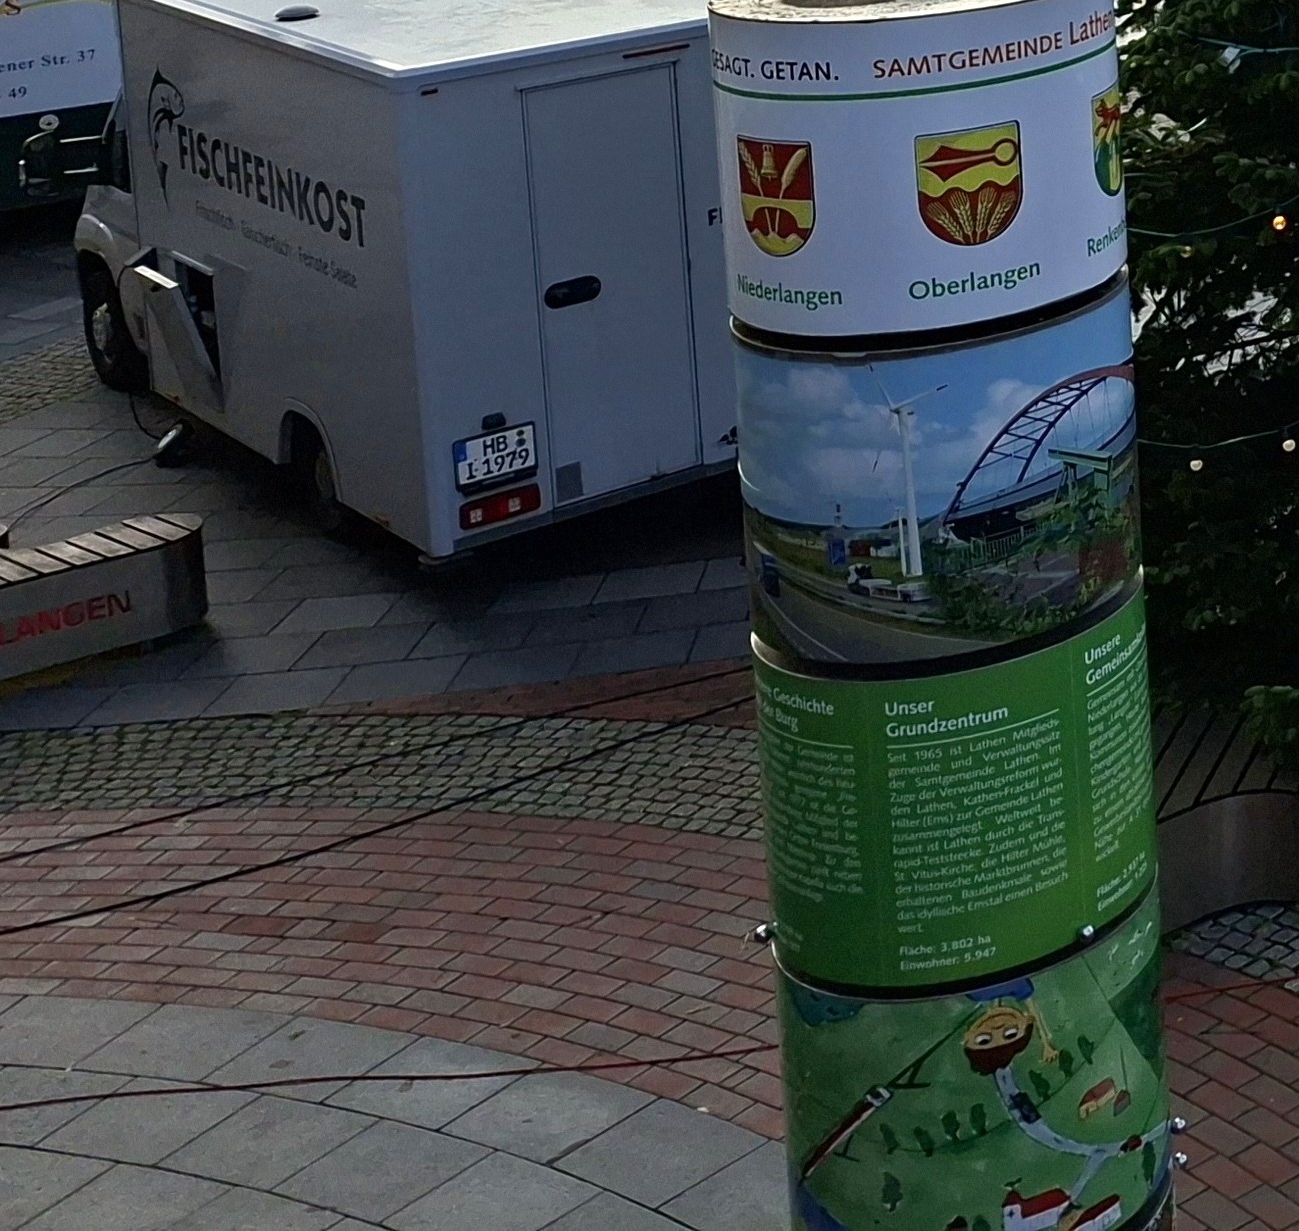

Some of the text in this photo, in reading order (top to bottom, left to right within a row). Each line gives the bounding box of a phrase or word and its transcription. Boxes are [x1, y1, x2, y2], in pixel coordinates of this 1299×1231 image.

[40, 54, 70, 67] Str.
[77, 49, 96, 63] 37
[760, 60, 840, 81] GETAN.
[872, 31, 1062, 79] SAMTGEMEINDE
[8, 85, 28, 99] 49
[177, 123, 366, 247] FISCHFEINKOST
[737, 273, 843, 311] Niederlangen
[908, 262, 1041, 301] Oberlangen
[482, 435, 508, 457] HB
[1084, 634, 1120, 664] Unsere
[773, 687, 834, 716] Geschichte
[885, 701, 935, 717] Unser
[775, 707, 798, 733] Burg
[886, 707, 1008, 737] Grundzentrum
[916, 748, 942, 761] 1965
[950, 745, 962, 756] ist
[970, 737, 1006, 751] Lathen
[951, 756, 972, 769] und
[888, 778, 906, 789] der
[915, 766, 996, 787] Samtgemeinde
[1048, 743, 1061, 755] Im
[890, 792, 916, 805] Zuge
[919, 789, 936, 800] der
[939, 765, 1039, 797] Verwaltungsreform
[890, 805, 910, 816] den
[1044, 767, 1062, 783] und
[956, 811, 972, 821] zur
[975, 795, 1030, 817] Gemeinde
[1031, 783, 1063, 801] Lathen
[994, 803, 1040, 825] Weltweit
[927, 841, 940, 851] ist
[944, 836, 980, 849] Lathen
[985, 825, 1014, 841] durch
[1018, 821, 1034, 831] die
[988, 837, 1025, 854] Zudem
[1052, 821, 1066, 833] die
[895, 885, 912, 895] der
[1053, 847, 1067, 859] die
[981, 857, 998, 868] die
[897, 910, 916, 920] das
[968, 893, 1003, 911] Emstal
[1005, 886, 1033, 902] einen
[1035, 871, 1068, 892] Besuch
[900, 947, 996, 971] Einwohner: 5.947
[941, 937, 974, 953] 3.802
[978, 935, 992, 945] ha
